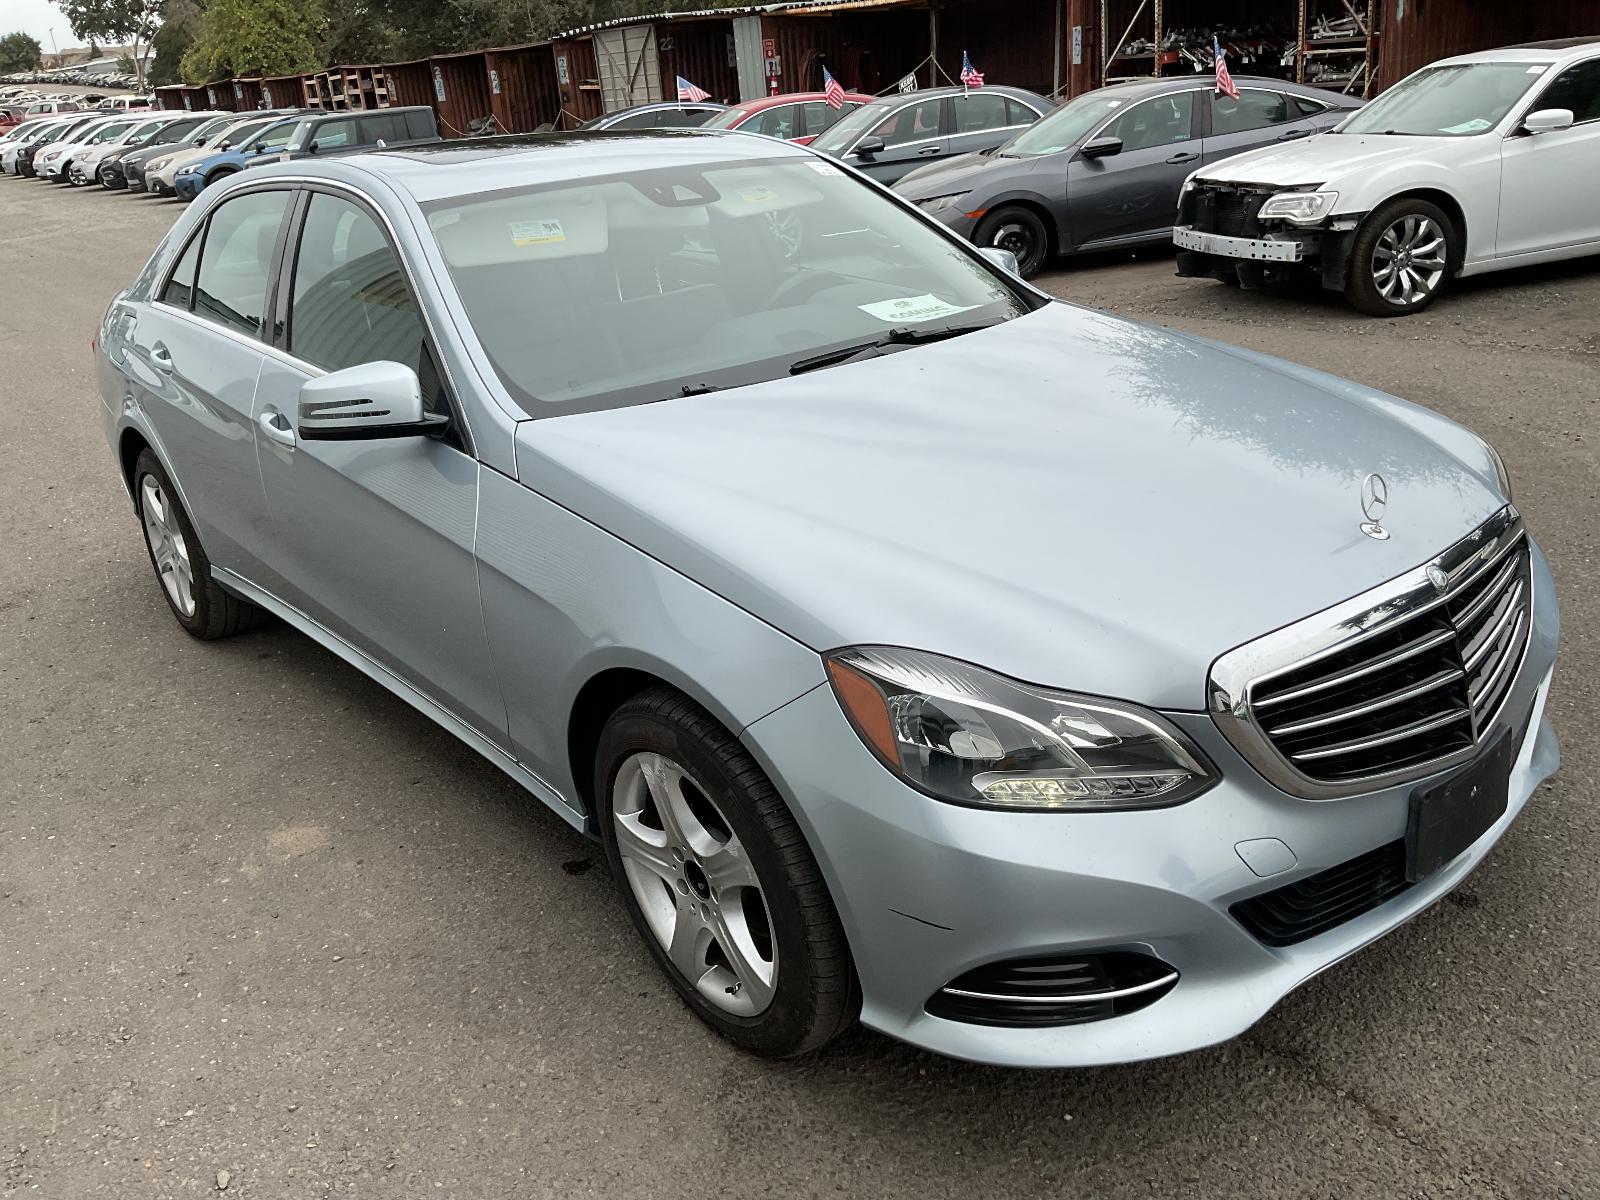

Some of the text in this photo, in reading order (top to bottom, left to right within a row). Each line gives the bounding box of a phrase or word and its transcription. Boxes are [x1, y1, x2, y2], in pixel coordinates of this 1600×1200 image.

[559, 58, 567, 79] 23
[900, 75, 914, 89] KEEP
[904, 84, 914, 93] OUT
